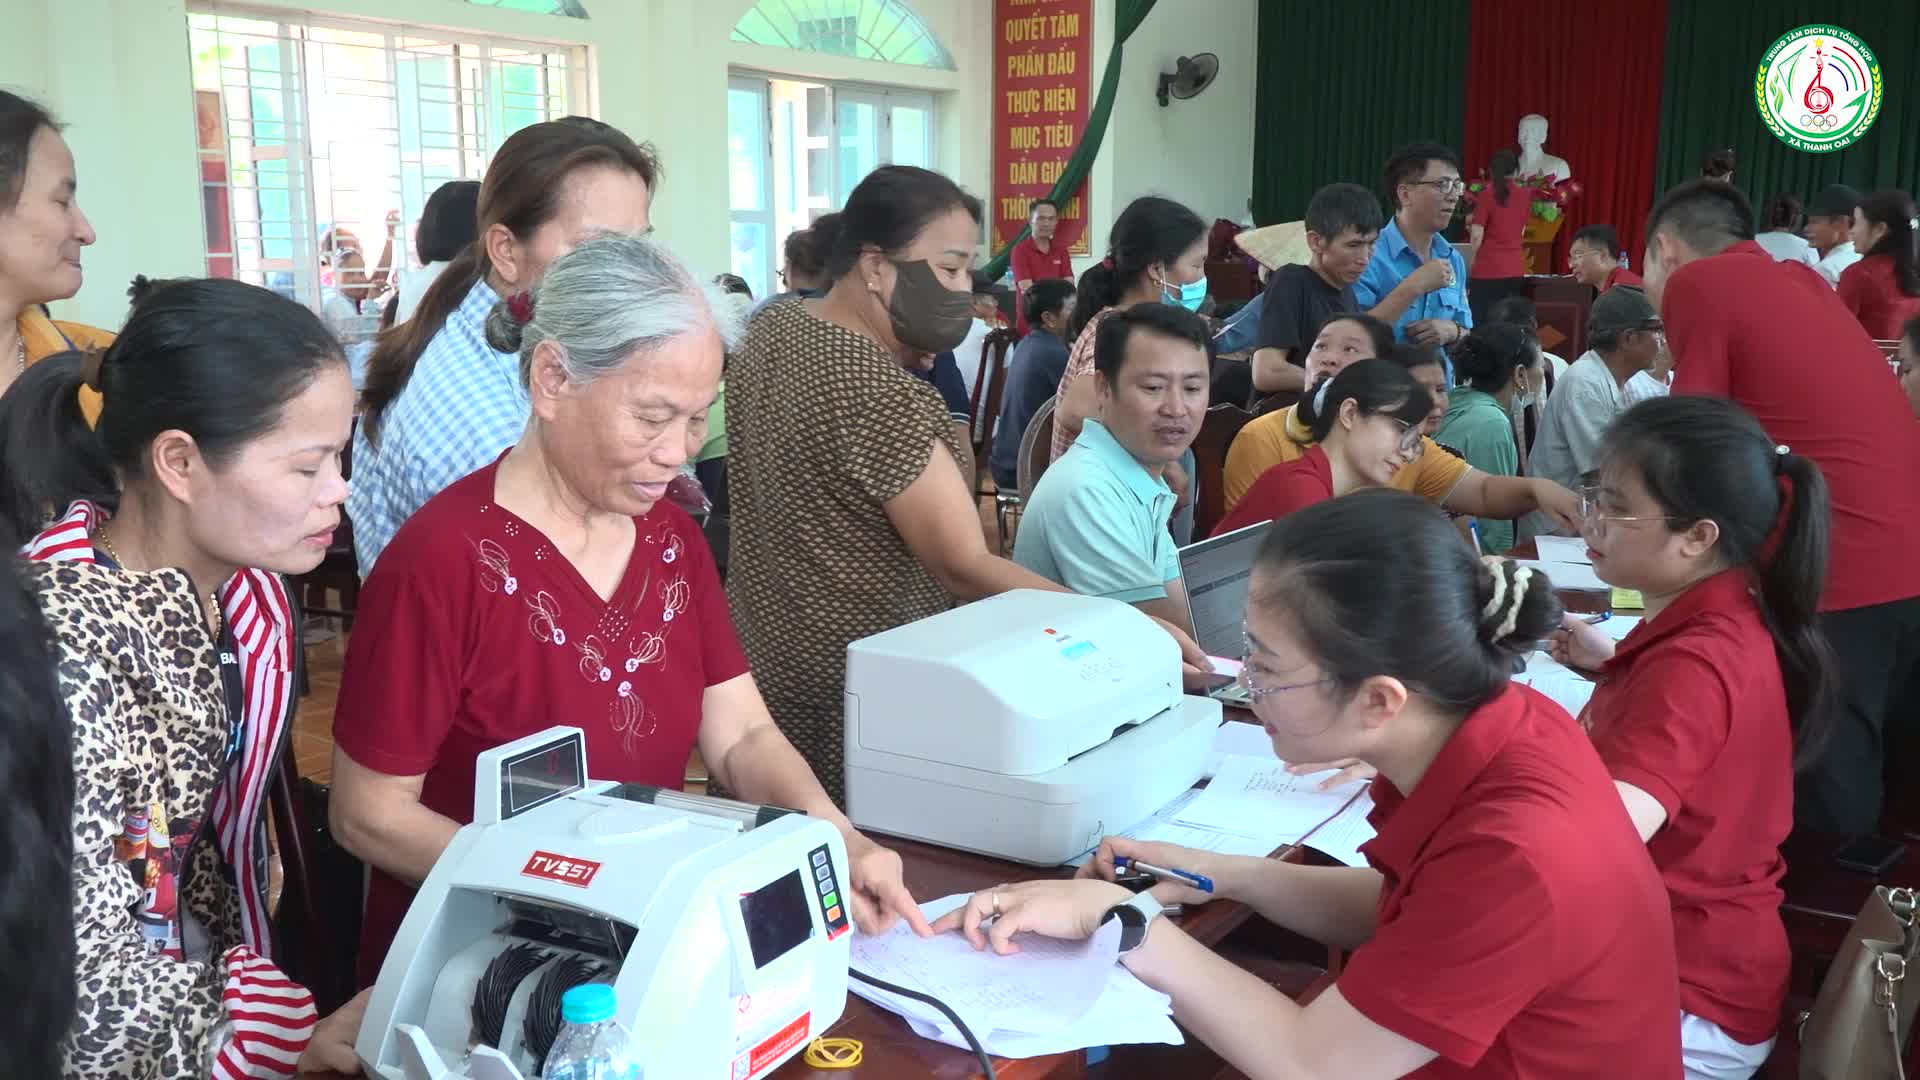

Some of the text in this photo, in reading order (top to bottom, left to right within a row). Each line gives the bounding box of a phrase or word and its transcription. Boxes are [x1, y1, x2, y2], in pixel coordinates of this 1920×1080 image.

[1006, 8, 1079, 45] QUYẾT TÂM
[1008, 42, 1076, 78] PHẤN ĐẤU
[1007, 83, 1076, 118] THỰC HIỆN
[1010, 120, 1073, 153] MỤC TIÊU
[1010, 156, 1068, 184] DÂN GIÀ
